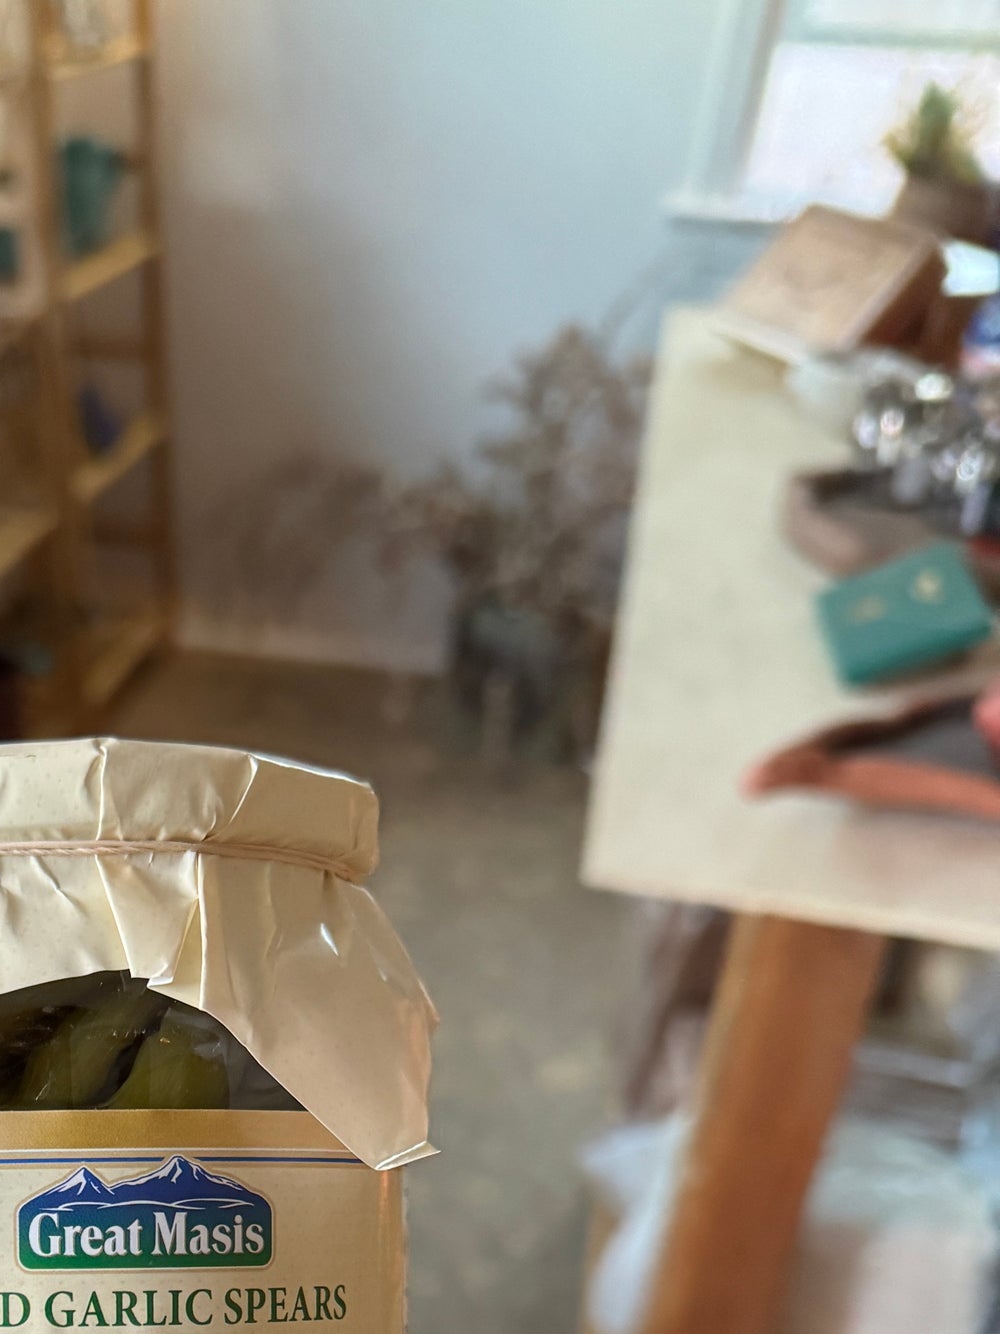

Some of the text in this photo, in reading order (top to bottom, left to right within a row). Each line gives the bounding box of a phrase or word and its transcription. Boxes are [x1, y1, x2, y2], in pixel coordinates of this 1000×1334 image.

[28, 1211, 264, 1258] Great Masis
[44, 1288, 213, 1328] GARLIC
[224, 1284, 347, 1325] SPEARS
